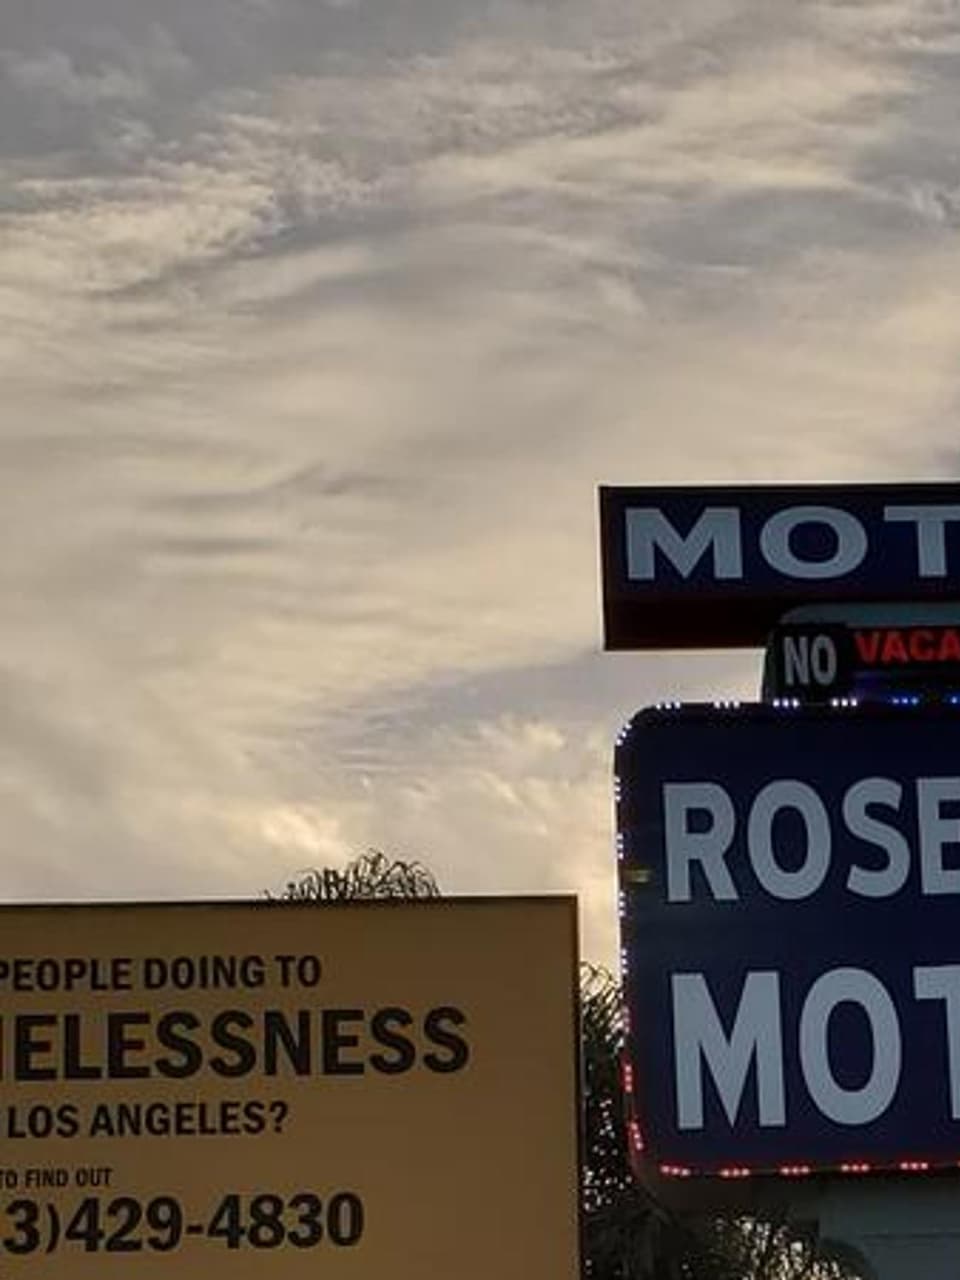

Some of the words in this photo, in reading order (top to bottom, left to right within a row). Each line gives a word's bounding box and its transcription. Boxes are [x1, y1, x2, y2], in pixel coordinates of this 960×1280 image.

[783, 634, 837, 686] NO
[143, 955, 266, 990] DOING
[275, 954, 322, 988] TO
[0, 1006, 470, 1082] ELESSNESS
[7, 1103, 79, 1139] LOS
[90, 1100, 289, 1138] ANGELES?
[24, 1168, 69, 1188] FIND
[75, 1167, 113, 1188] OUT
[3, 1193, 364, 1255] 3)429-4830
